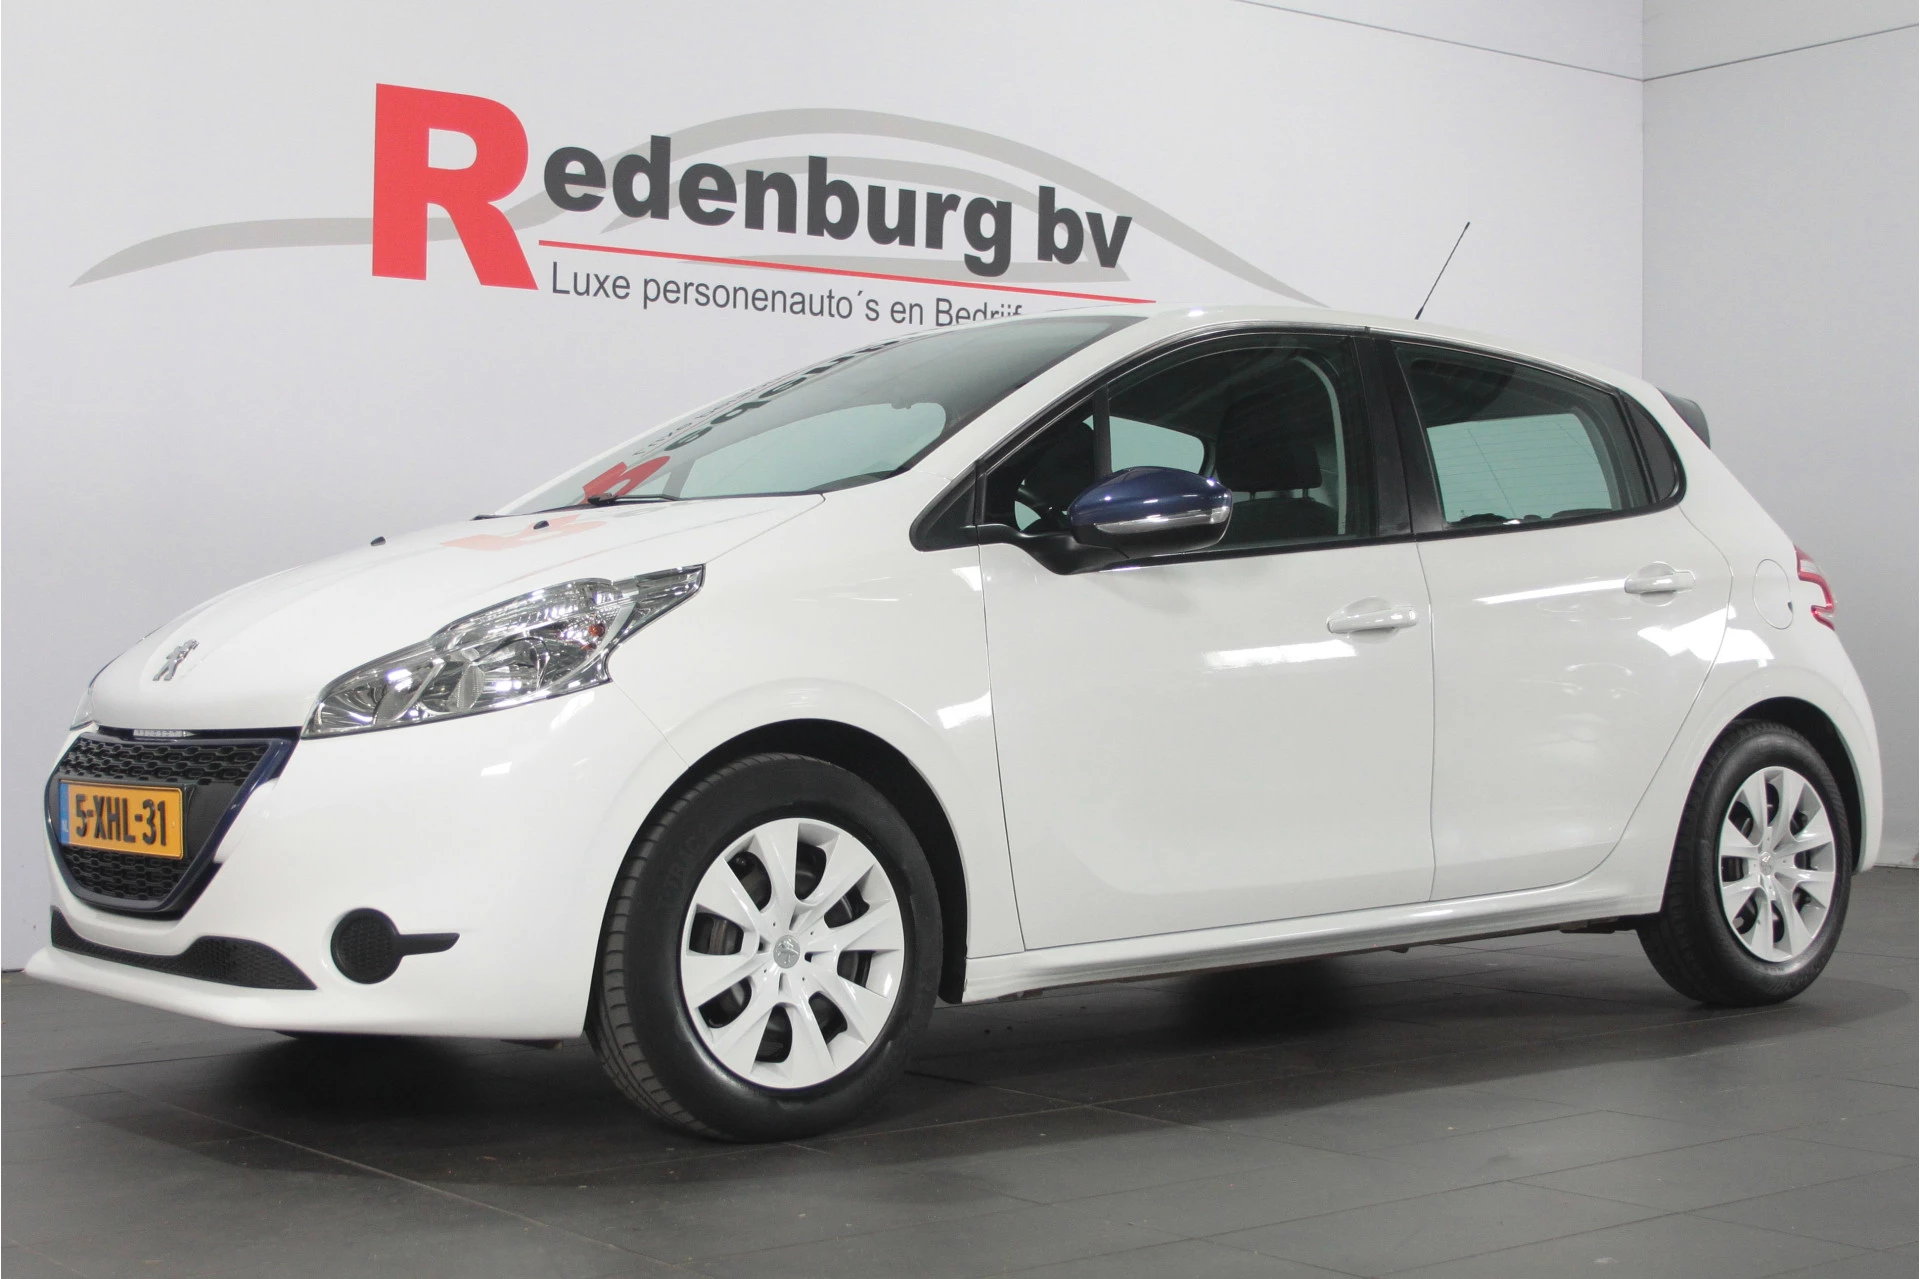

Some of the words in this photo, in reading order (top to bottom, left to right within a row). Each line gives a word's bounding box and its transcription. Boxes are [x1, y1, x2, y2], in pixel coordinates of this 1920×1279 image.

[372, 83, 1012, 290] Redenburg
[1037, 185, 1133, 269] bv
[551, 261, 631, 301] Luxe
[890, 301, 924, 327] en
[75, 793, 167, 847] 5-XHL-31
